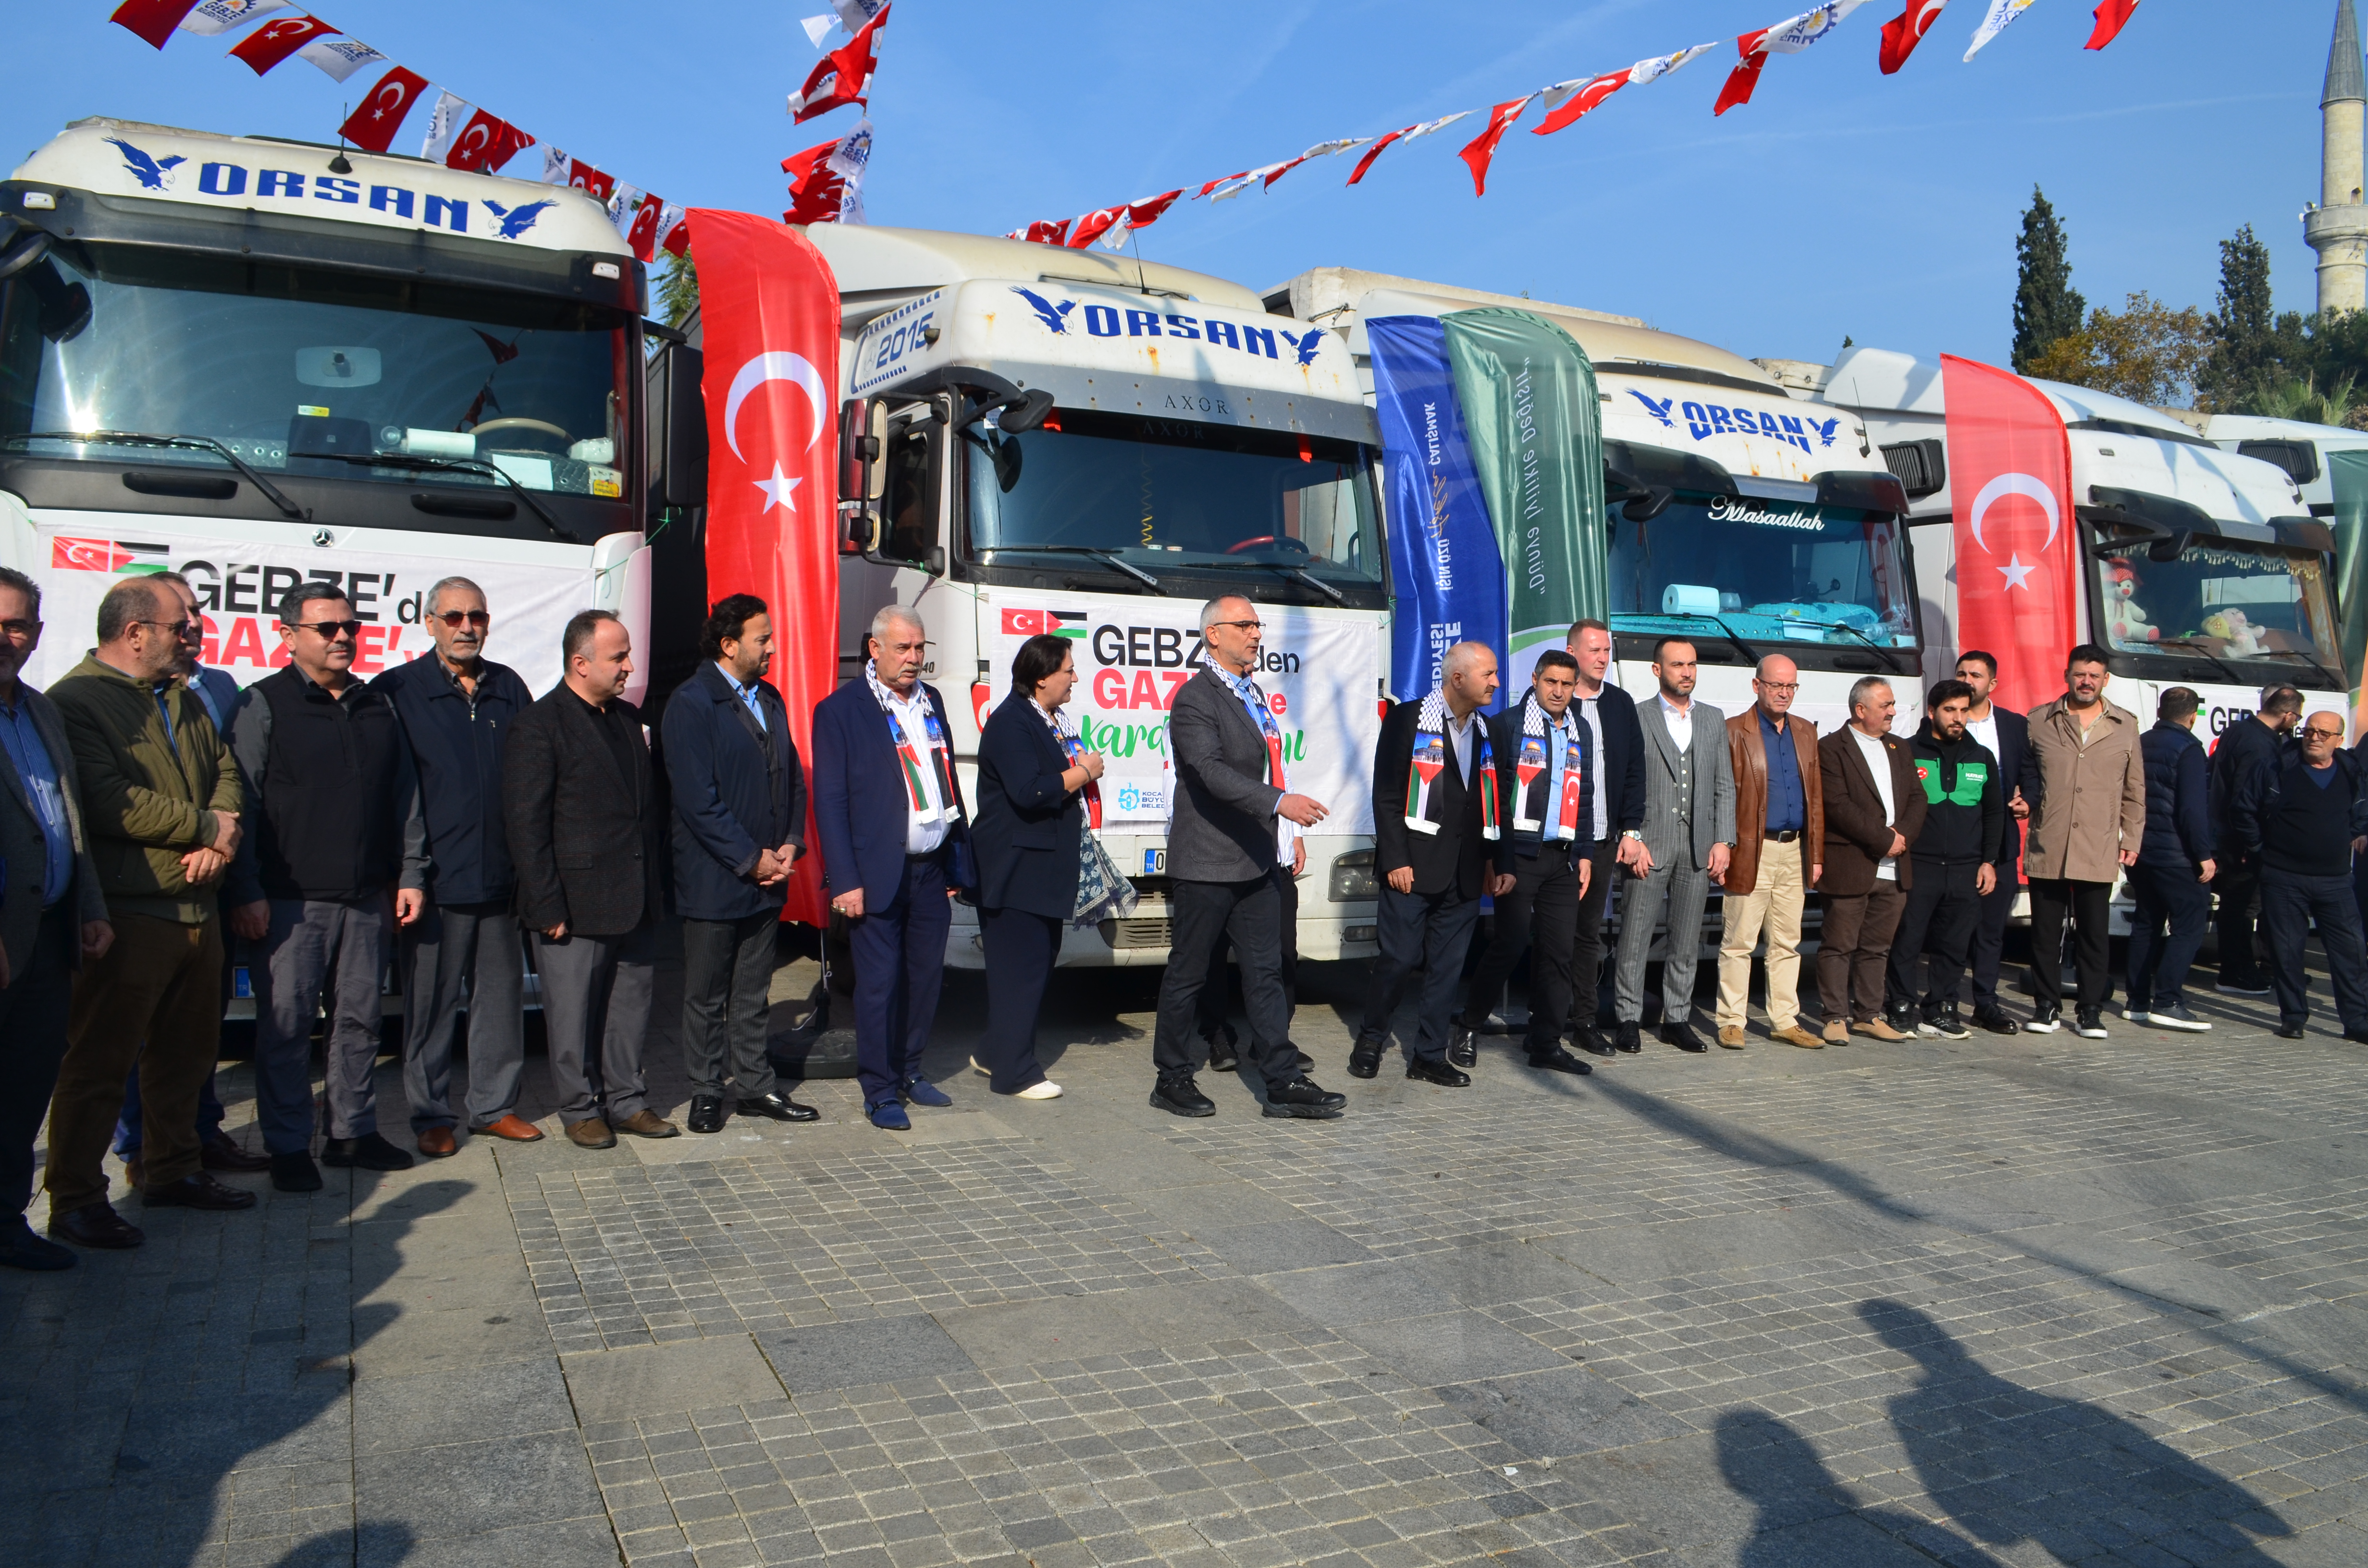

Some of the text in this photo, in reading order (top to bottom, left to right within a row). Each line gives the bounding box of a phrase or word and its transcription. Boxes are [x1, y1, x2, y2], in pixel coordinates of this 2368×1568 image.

[205, 1, 241, 20] GEBZE
[198, 161, 468, 233] ORSAN
[876, 311, 934, 369] 2015
[1084, 305, 1279, 359] ORSAN
[1164, 394, 1229, 415] AXOR
[1682, 401, 1812, 455] ORSAN
